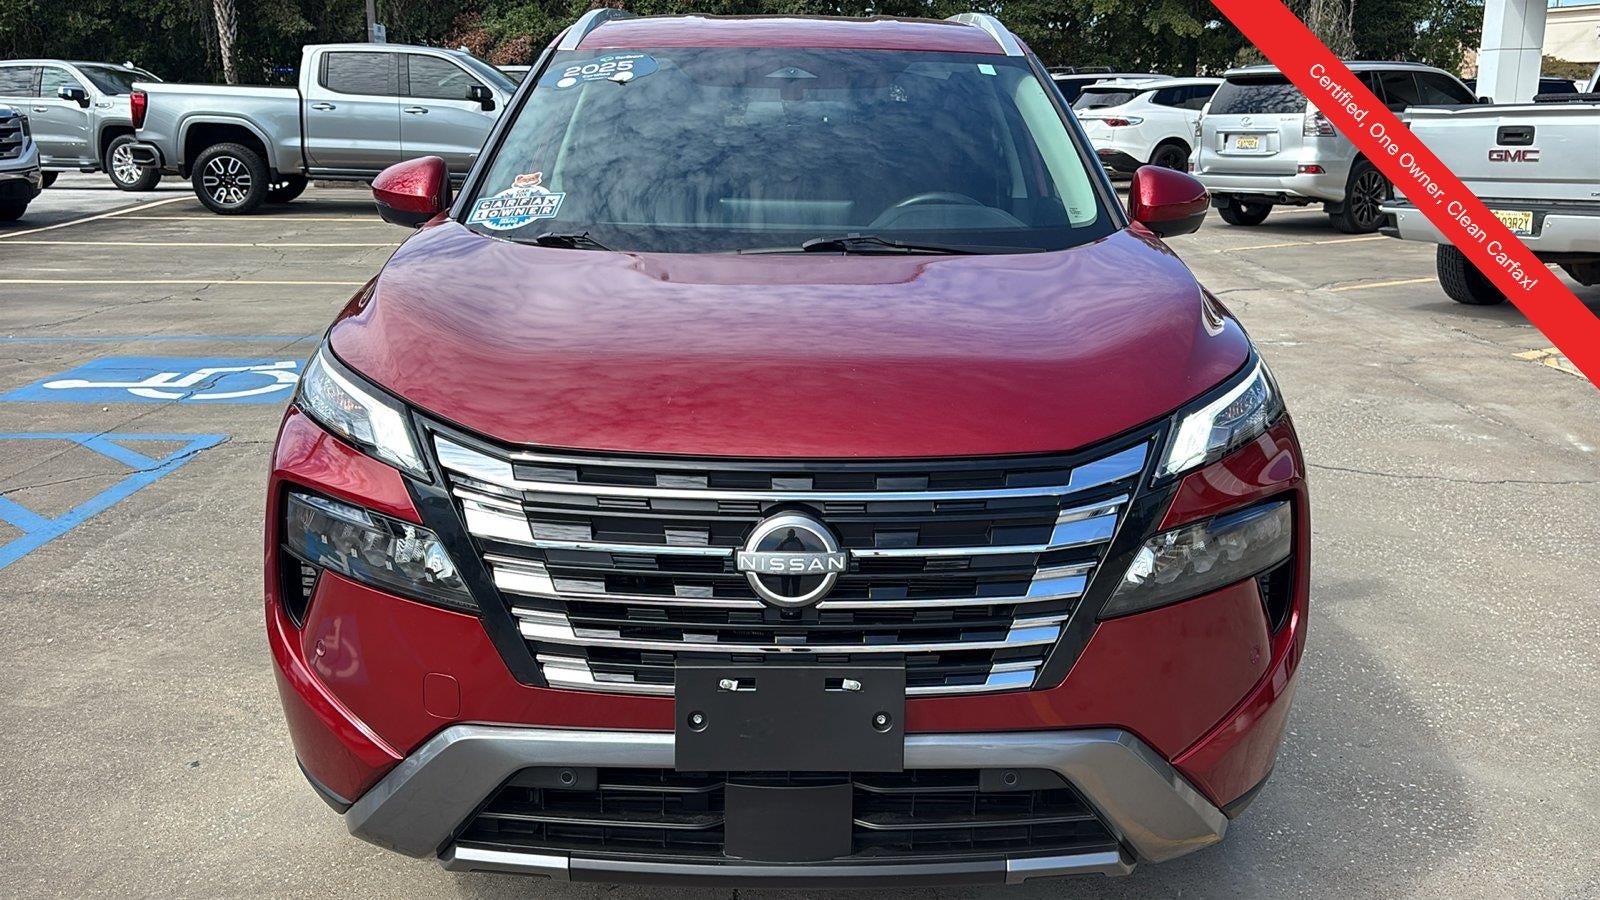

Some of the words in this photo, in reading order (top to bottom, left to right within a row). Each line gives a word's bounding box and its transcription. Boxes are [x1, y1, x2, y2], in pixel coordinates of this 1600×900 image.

[563, 60, 634, 77] 2025
[1488, 149, 1540, 162] GMC
[480, 197, 556, 209] CARFAX
[1498, 216, 1530, 231] 03R2Y
[740, 556, 844, 571] NISSAN
